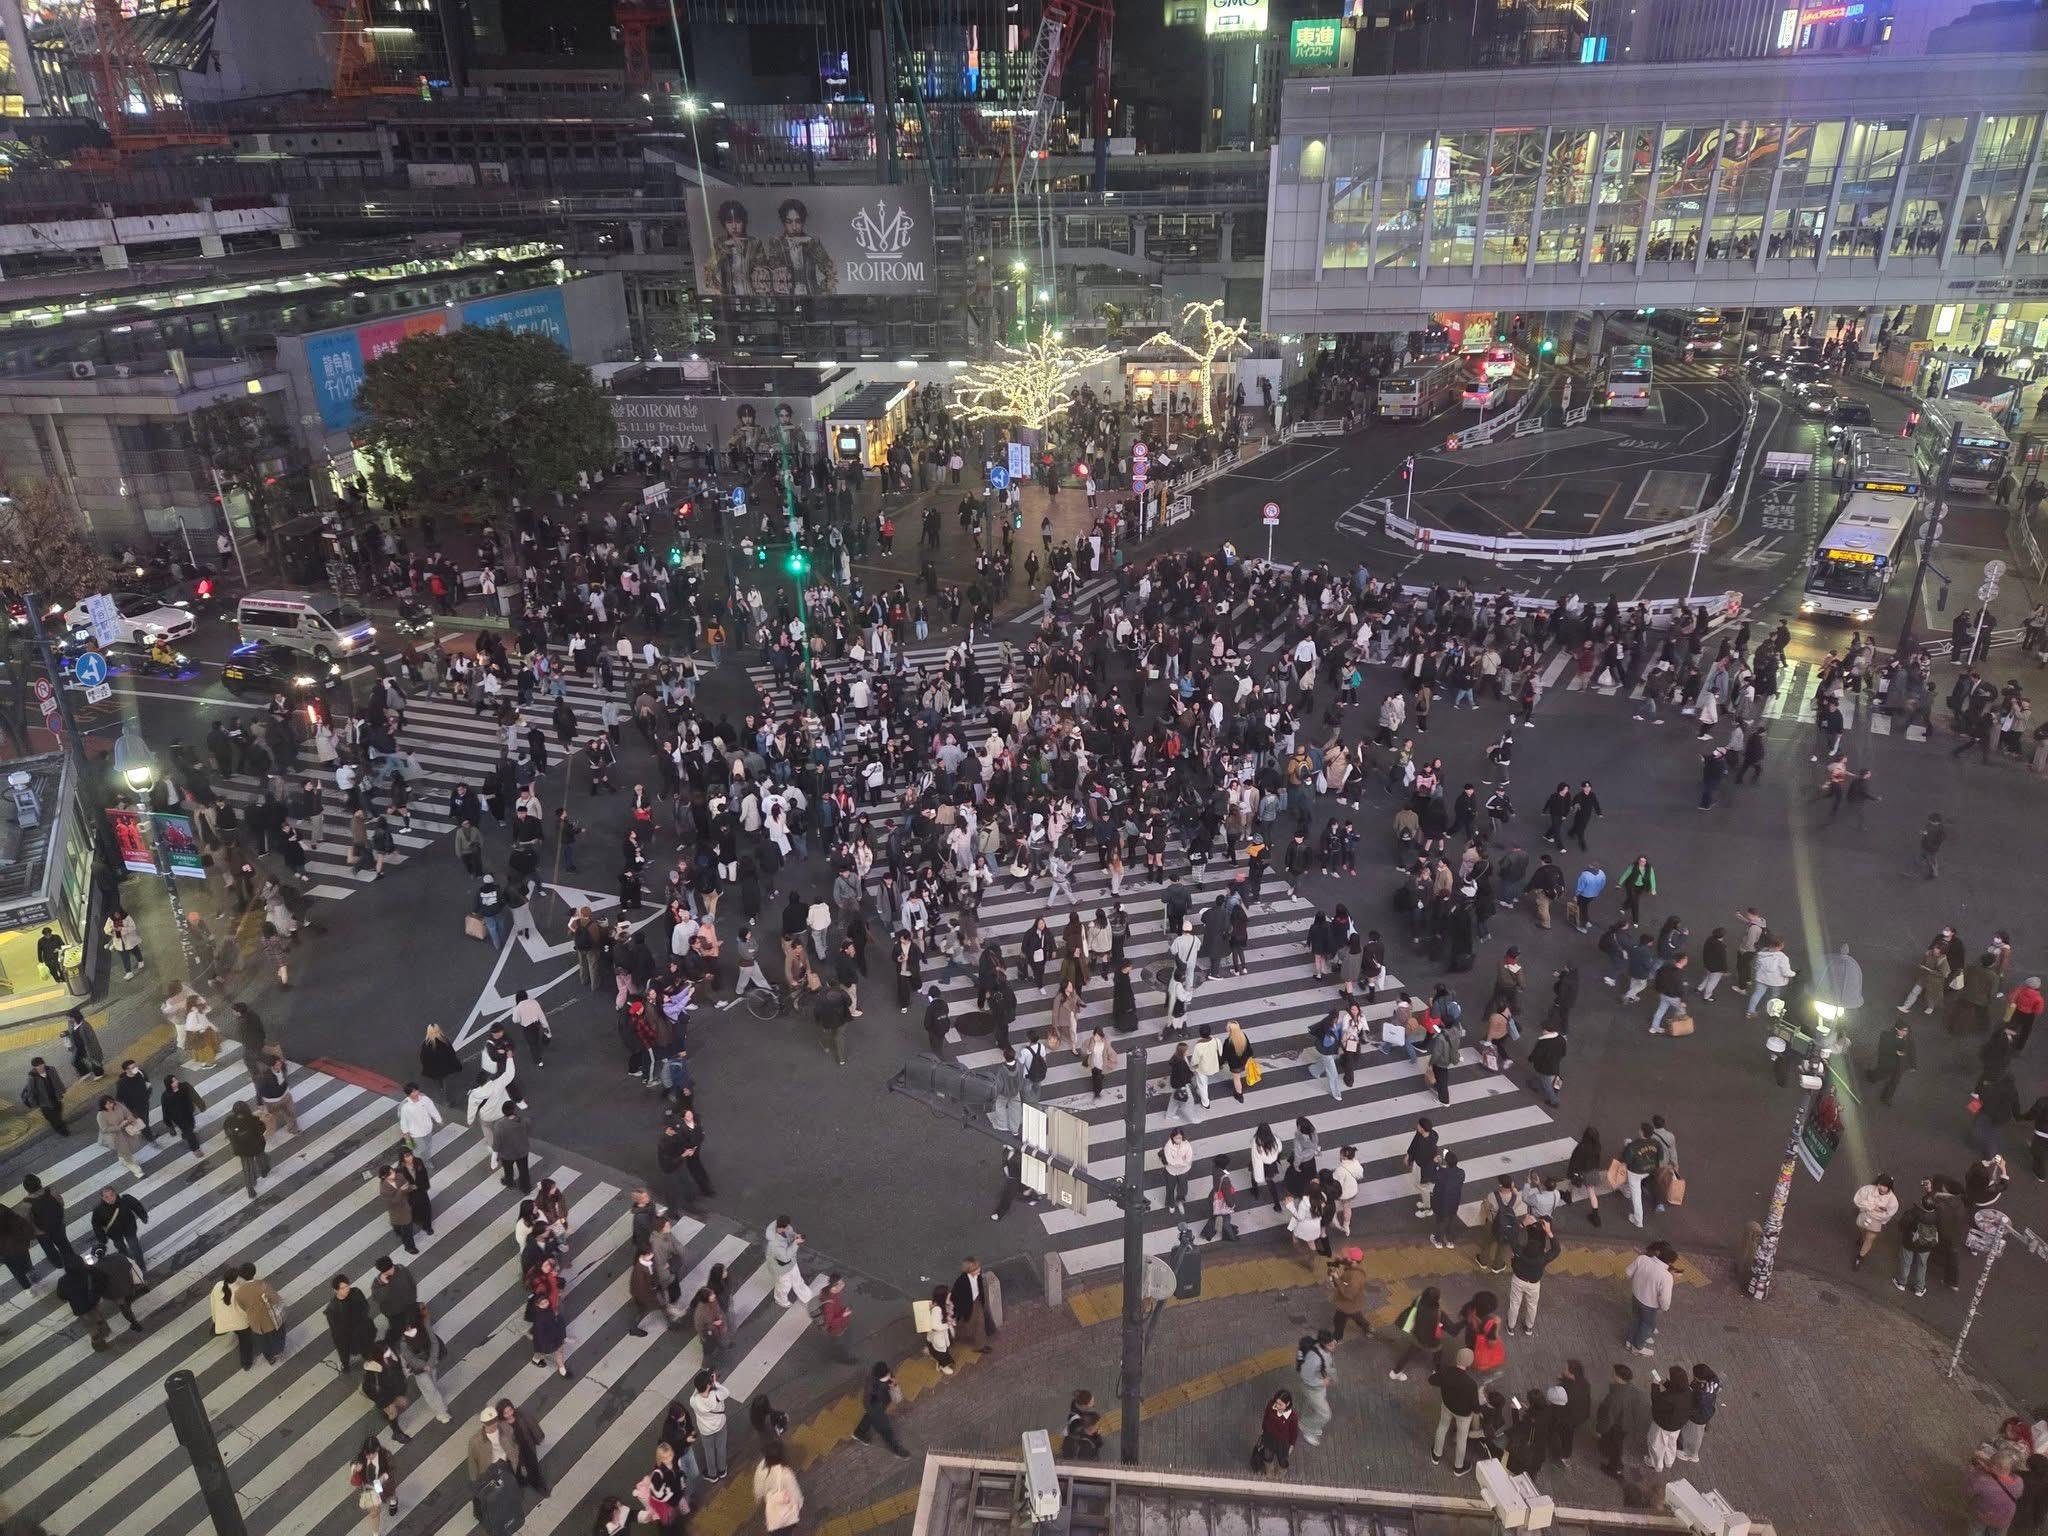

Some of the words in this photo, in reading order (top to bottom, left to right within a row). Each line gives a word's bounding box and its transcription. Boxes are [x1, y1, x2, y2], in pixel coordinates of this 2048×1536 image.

[1296, 28, 1334, 46] 東進
[1296, 47, 1333, 58] ハイスクール
[846, 261, 924, 282] ROIROM
[626, 403, 681, 418] ROIROM
[659, 422, 708, 432] Pre-Debut
[620, 434, 653, 449] Dear
